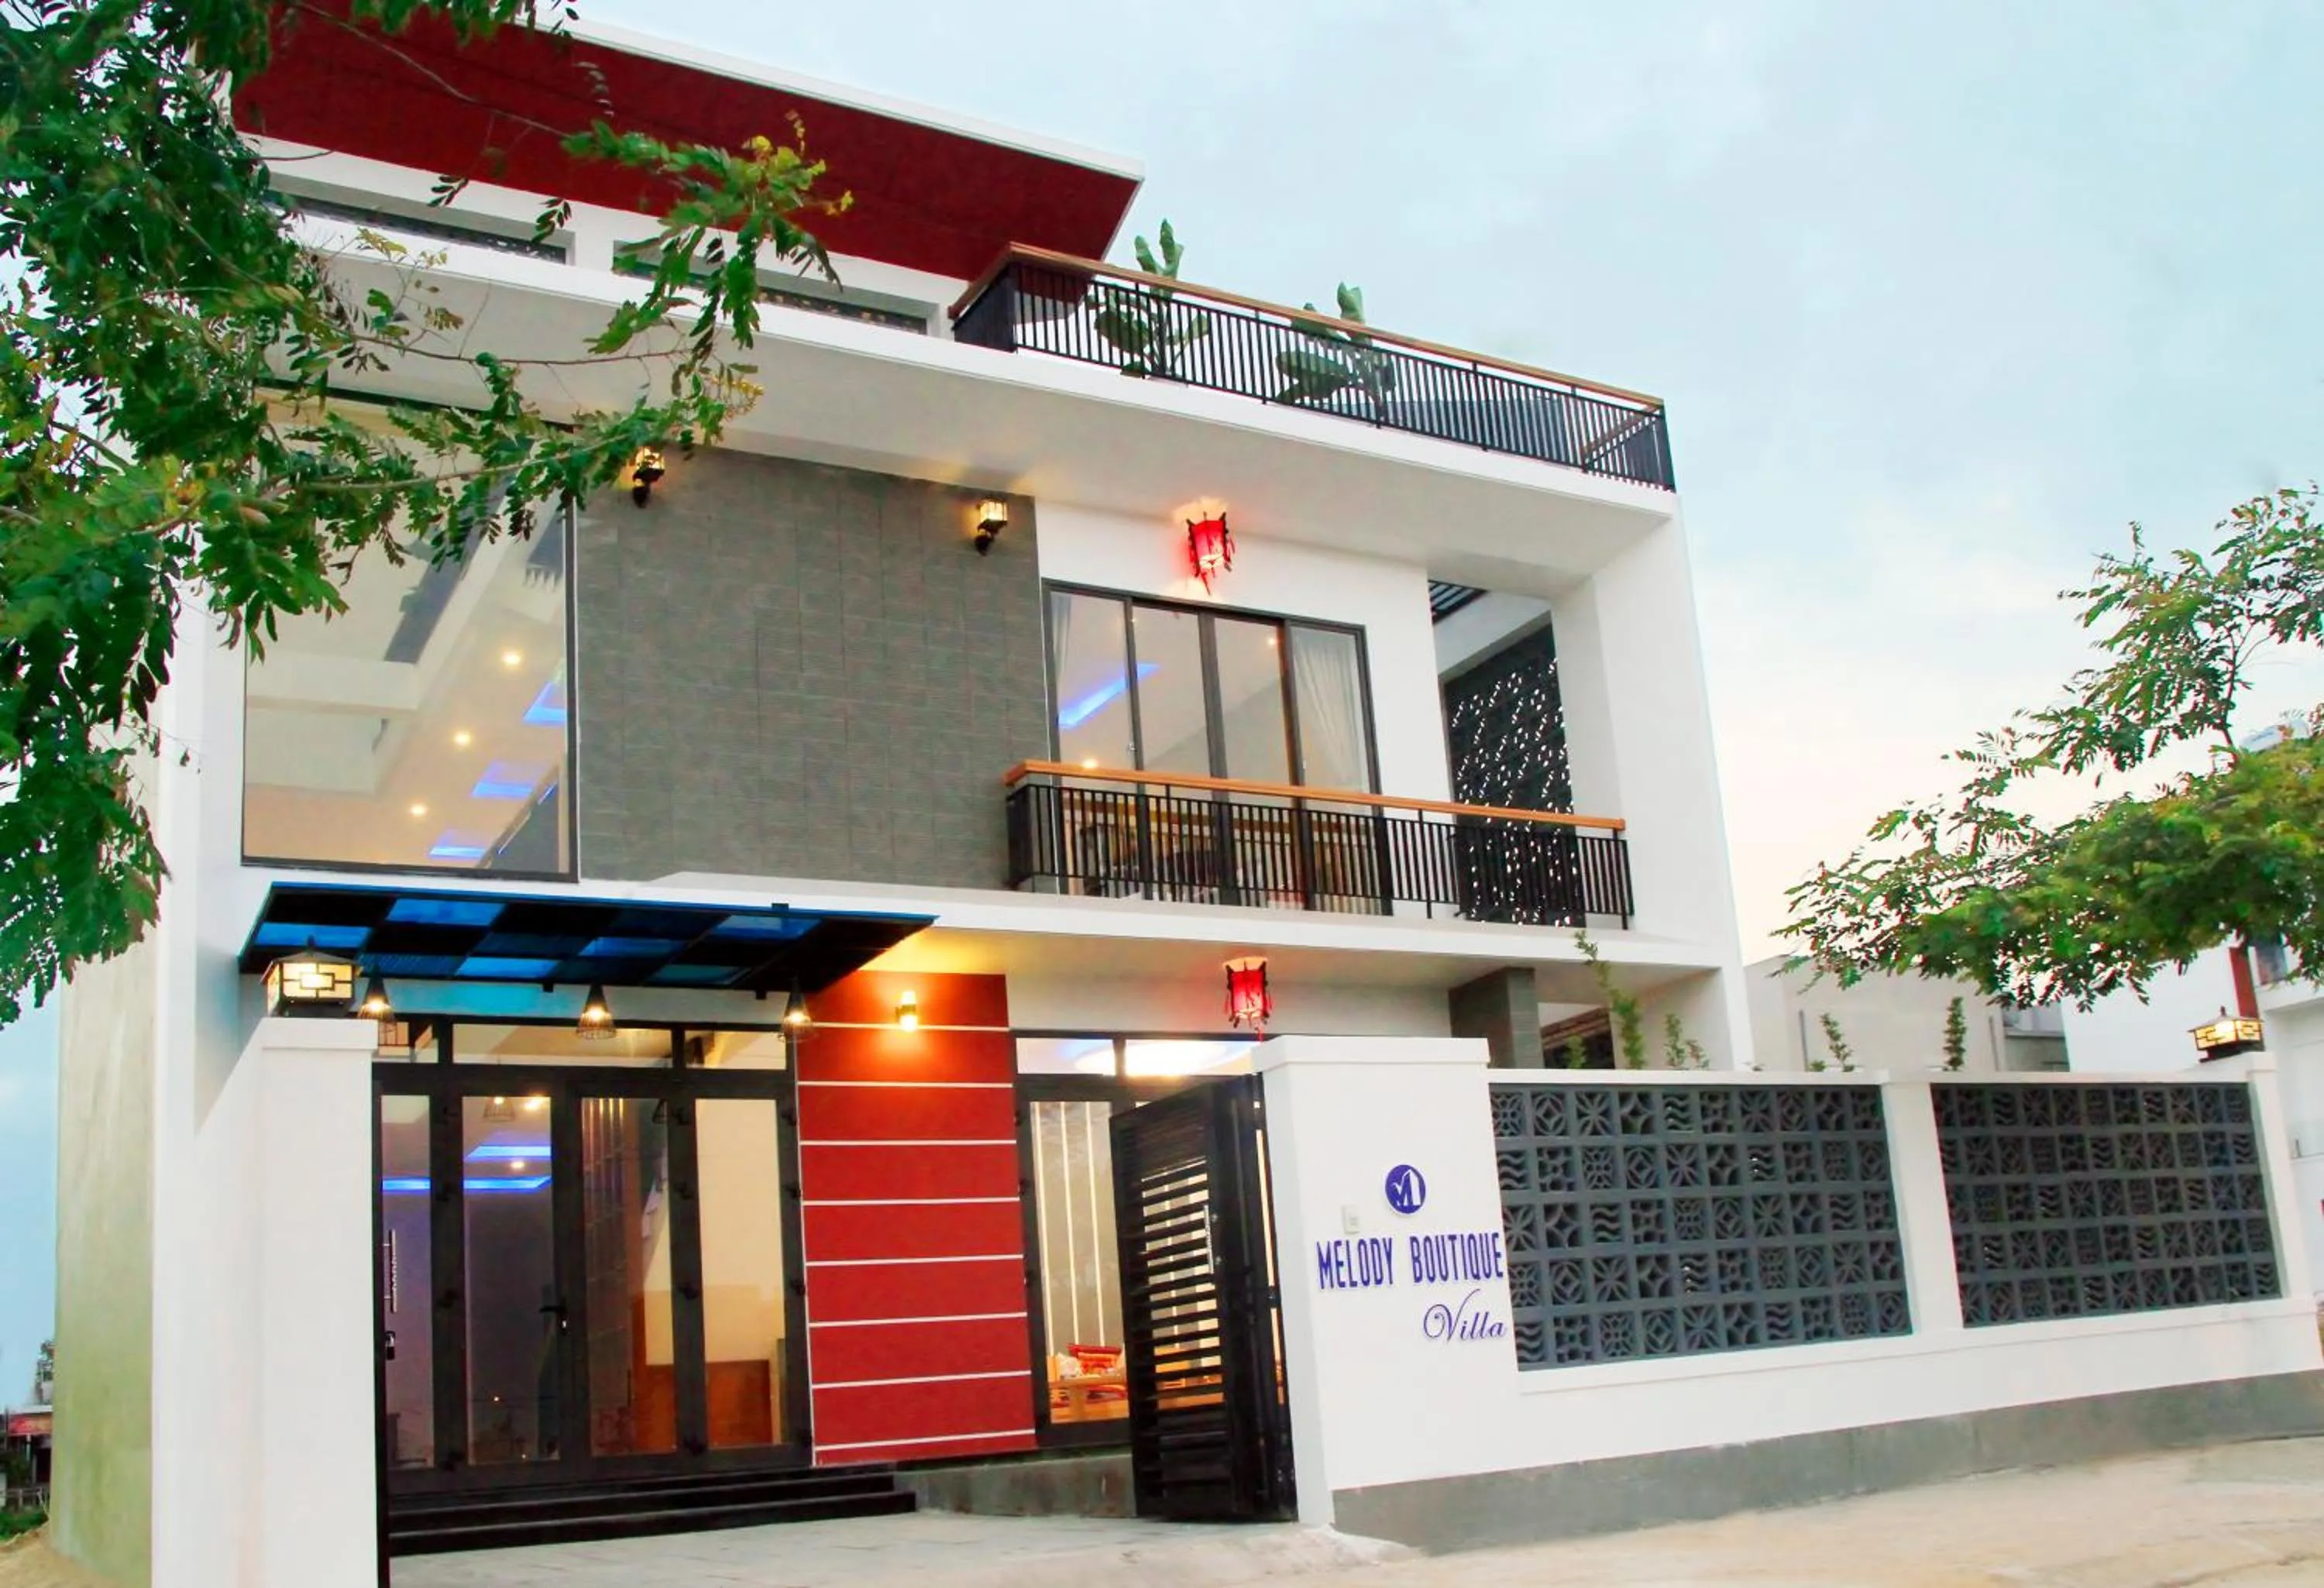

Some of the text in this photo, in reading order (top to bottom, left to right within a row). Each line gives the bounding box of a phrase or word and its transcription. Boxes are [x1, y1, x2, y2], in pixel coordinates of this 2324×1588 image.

[1317, 1232, 1504, 1289] MELODY BOUTIQUE
[1423, 1288, 1505, 1342] Villa
